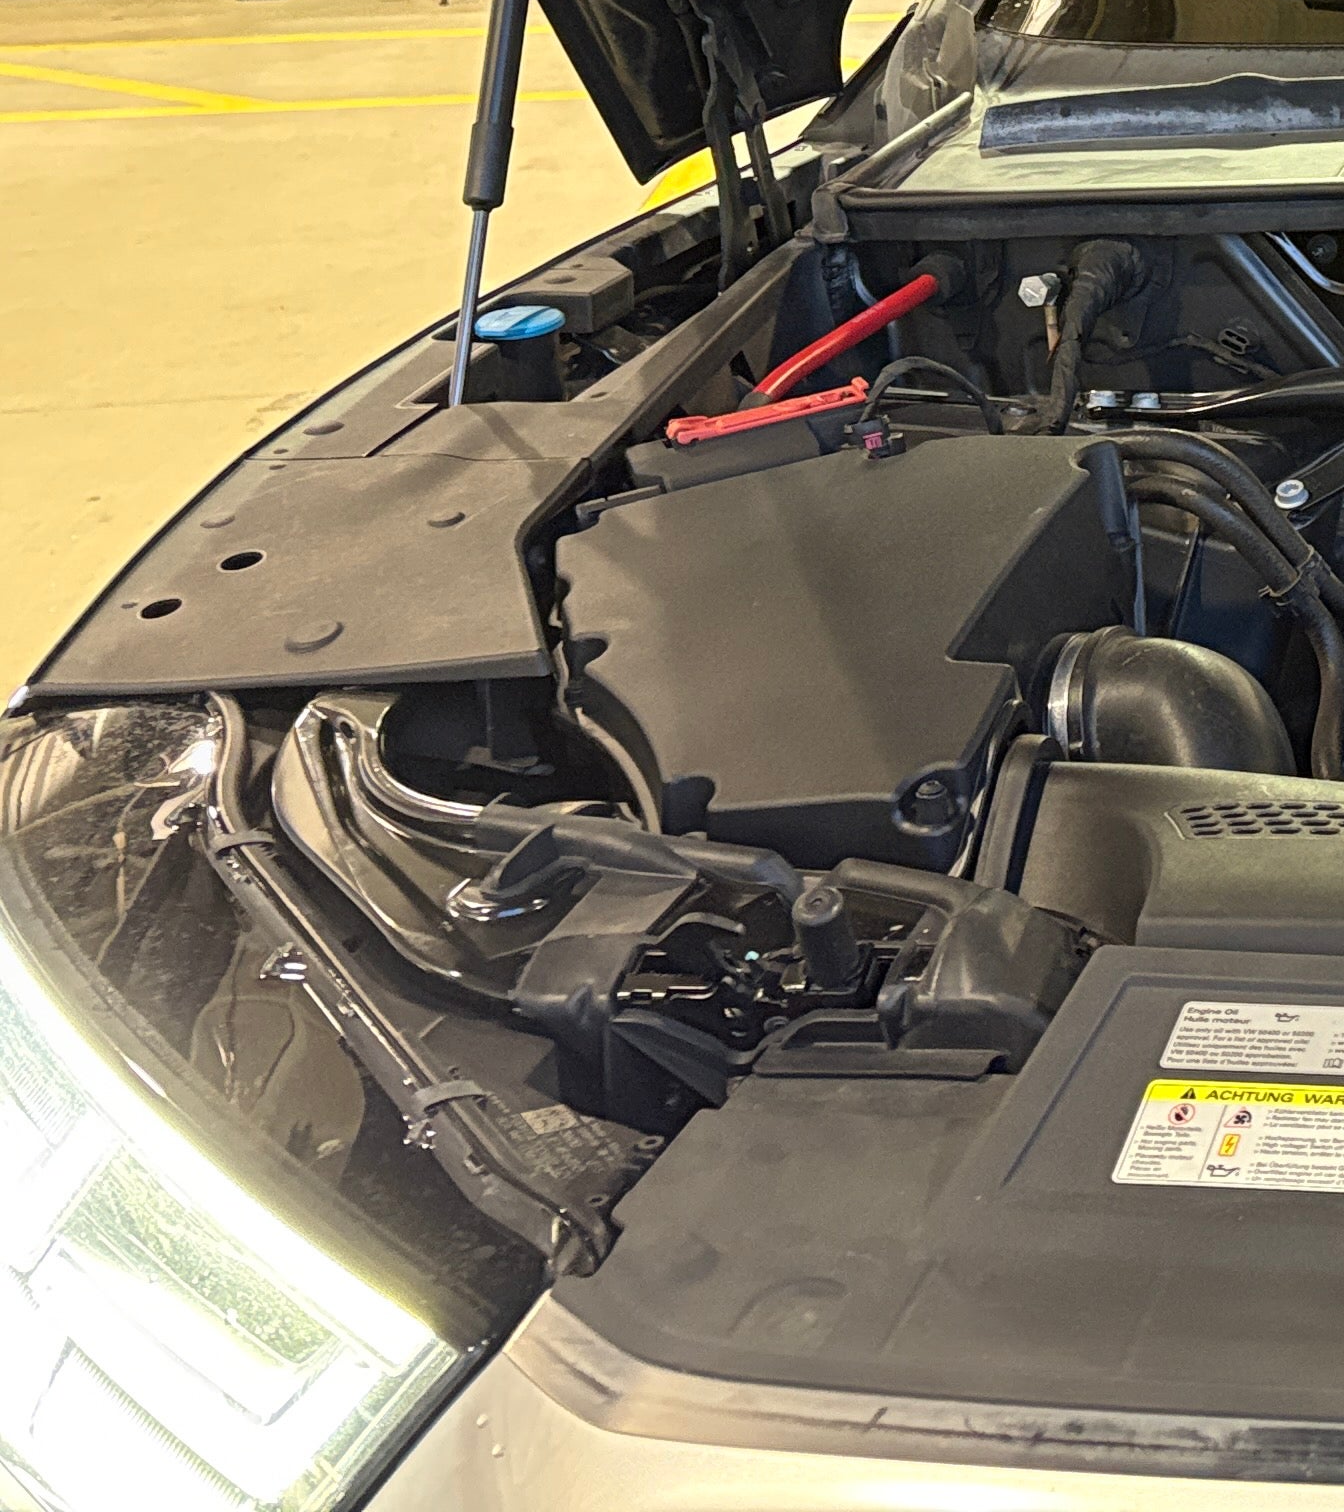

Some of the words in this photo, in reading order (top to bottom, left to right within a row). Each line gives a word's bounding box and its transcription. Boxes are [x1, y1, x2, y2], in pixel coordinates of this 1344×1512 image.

[1187, 1007, 1222, 1016] Engine
[1183, 1015, 1209, 1023] Huile
[1206, 1090, 1294, 1104] ACHTUNG
